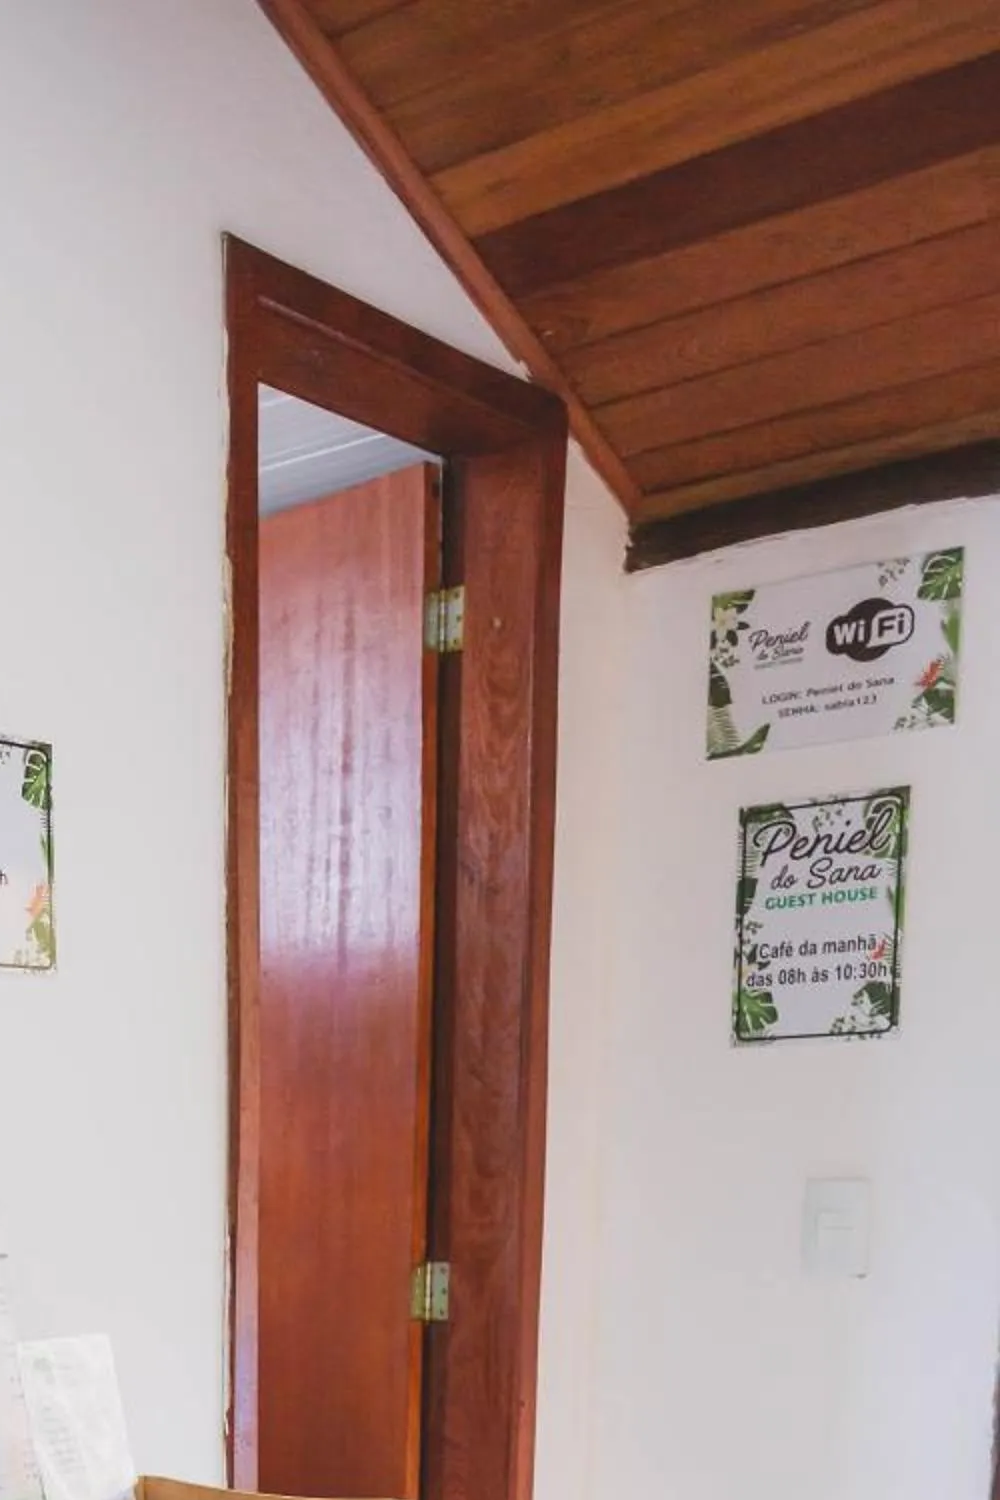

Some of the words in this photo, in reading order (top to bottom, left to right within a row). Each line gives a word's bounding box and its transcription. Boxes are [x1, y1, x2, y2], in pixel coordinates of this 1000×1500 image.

[748, 621, 811, 652] Peniel
[832, 612, 906, 646] WiFi
[865, 677, 895, 688] Sana
[753, 806, 894, 868] Peniel
[770, 864, 797, 891] do
[807, 857, 881, 889] Sana
[764, 893, 817, 911] GUEST
[821, 886, 878, 905] HOUSE
[758, 940, 793, 960] Café
[798, 940, 818, 957] da
[822, 934, 877, 954] manhã
[746, 970, 773, 988] das
[777, 966, 806, 986] 08h
[811, 965, 829, 984] às
[834, 960, 887, 981] 10:30h
